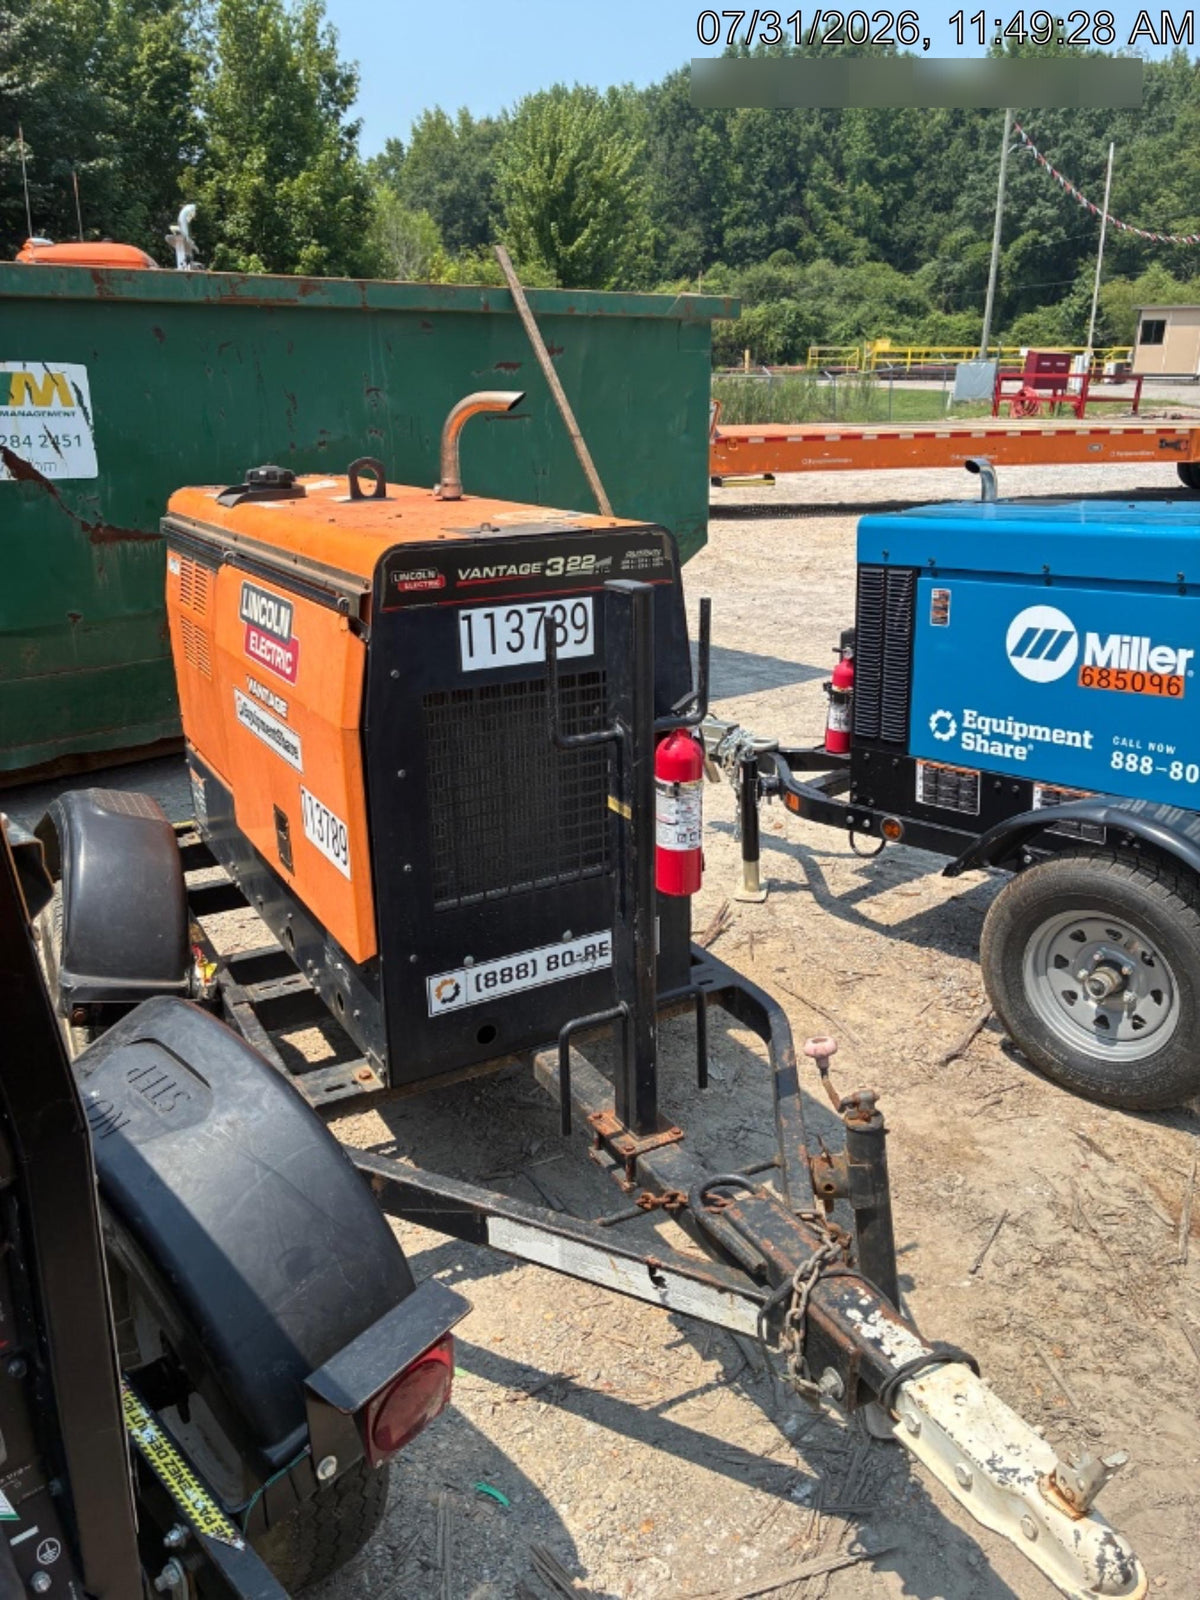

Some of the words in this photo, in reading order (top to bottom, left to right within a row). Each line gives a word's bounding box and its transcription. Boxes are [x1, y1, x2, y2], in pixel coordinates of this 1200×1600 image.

[0, 372, 75, 407] M
[394, 570, 436, 582] LINCOLN
[458, 562, 544, 580] VANTAGE
[545, 554, 596, 576] 322
[241, 588, 291, 640] LINCOLN
[461, 602, 590, 658] 113789
[249, 631, 293, 675] ELECTRIC
[1083, 631, 1194, 676] Miller
[1081, 667, 1181, 696] 685096
[961, 731, 1028, 761] Share
[962, 709, 1094, 750] Equipment
[1112, 735, 1142, 750] CALL
[1148, 741, 1176, 755] NOW
[301, 789, 348, 866] 113789
[475, 959, 538, 992] (888)
